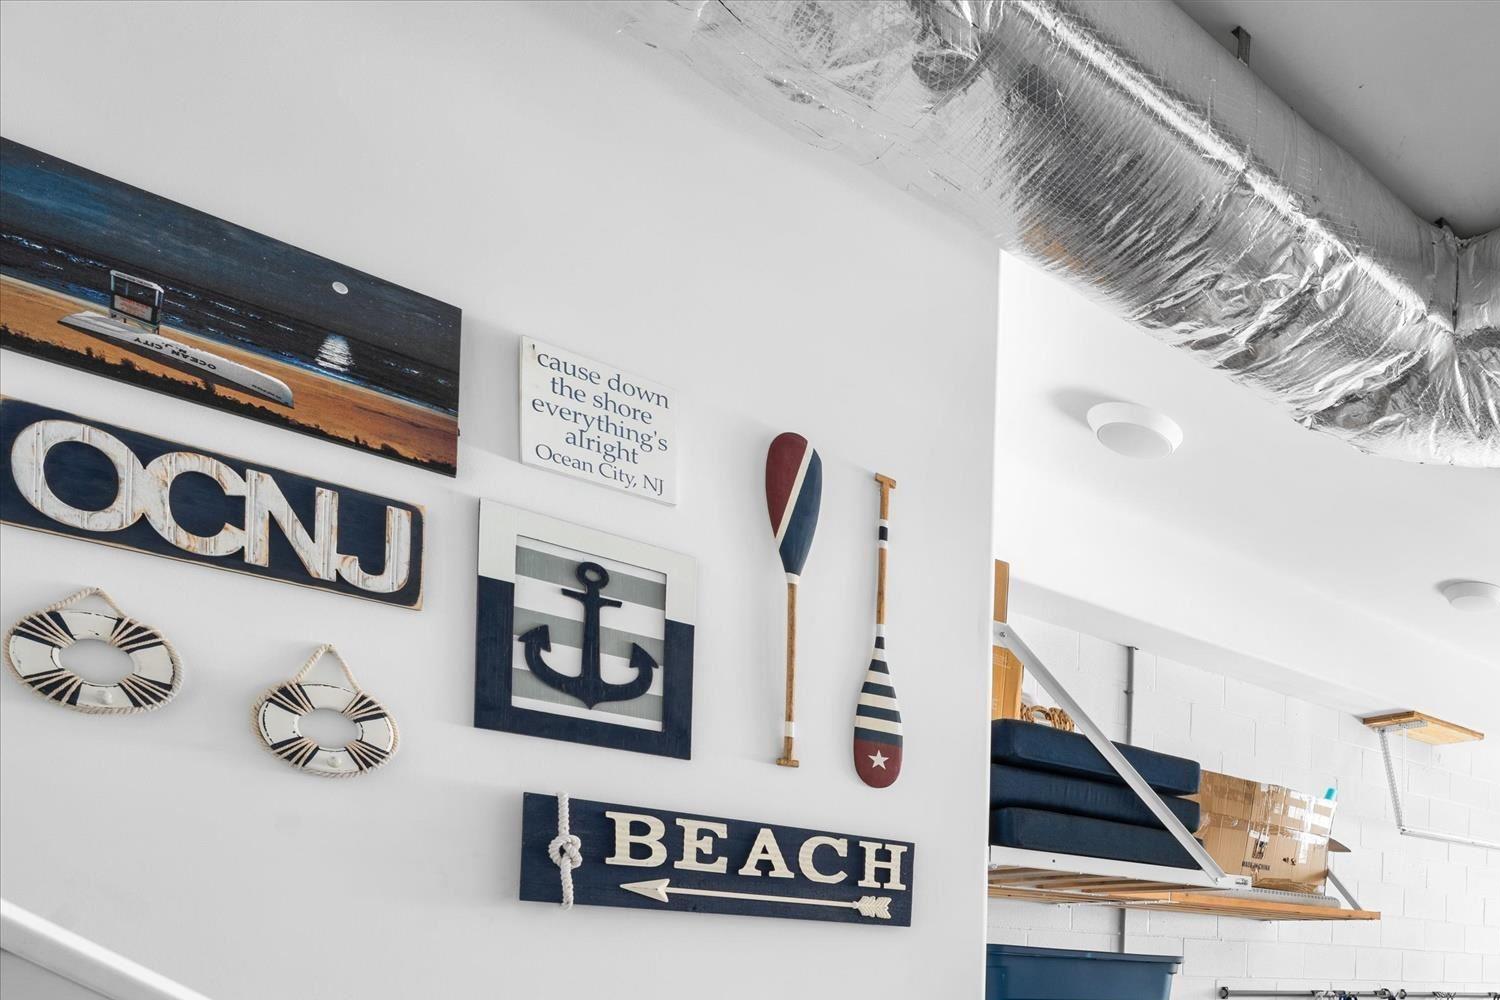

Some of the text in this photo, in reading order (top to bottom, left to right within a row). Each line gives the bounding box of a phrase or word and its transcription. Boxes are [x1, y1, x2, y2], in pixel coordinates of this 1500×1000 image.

[133, 337, 217, 370] OCEAN CITY
[531, 343, 670, 410] 'cause down
[531, 397, 668, 453] everything's
[550, 376, 653, 425] the shore
[535, 443, 665, 497] Ocean City, NJ
[565, 429, 639, 465] alright
[11, 419, 412, 594] OCNJ
[604, 810, 908, 891] BEACH
